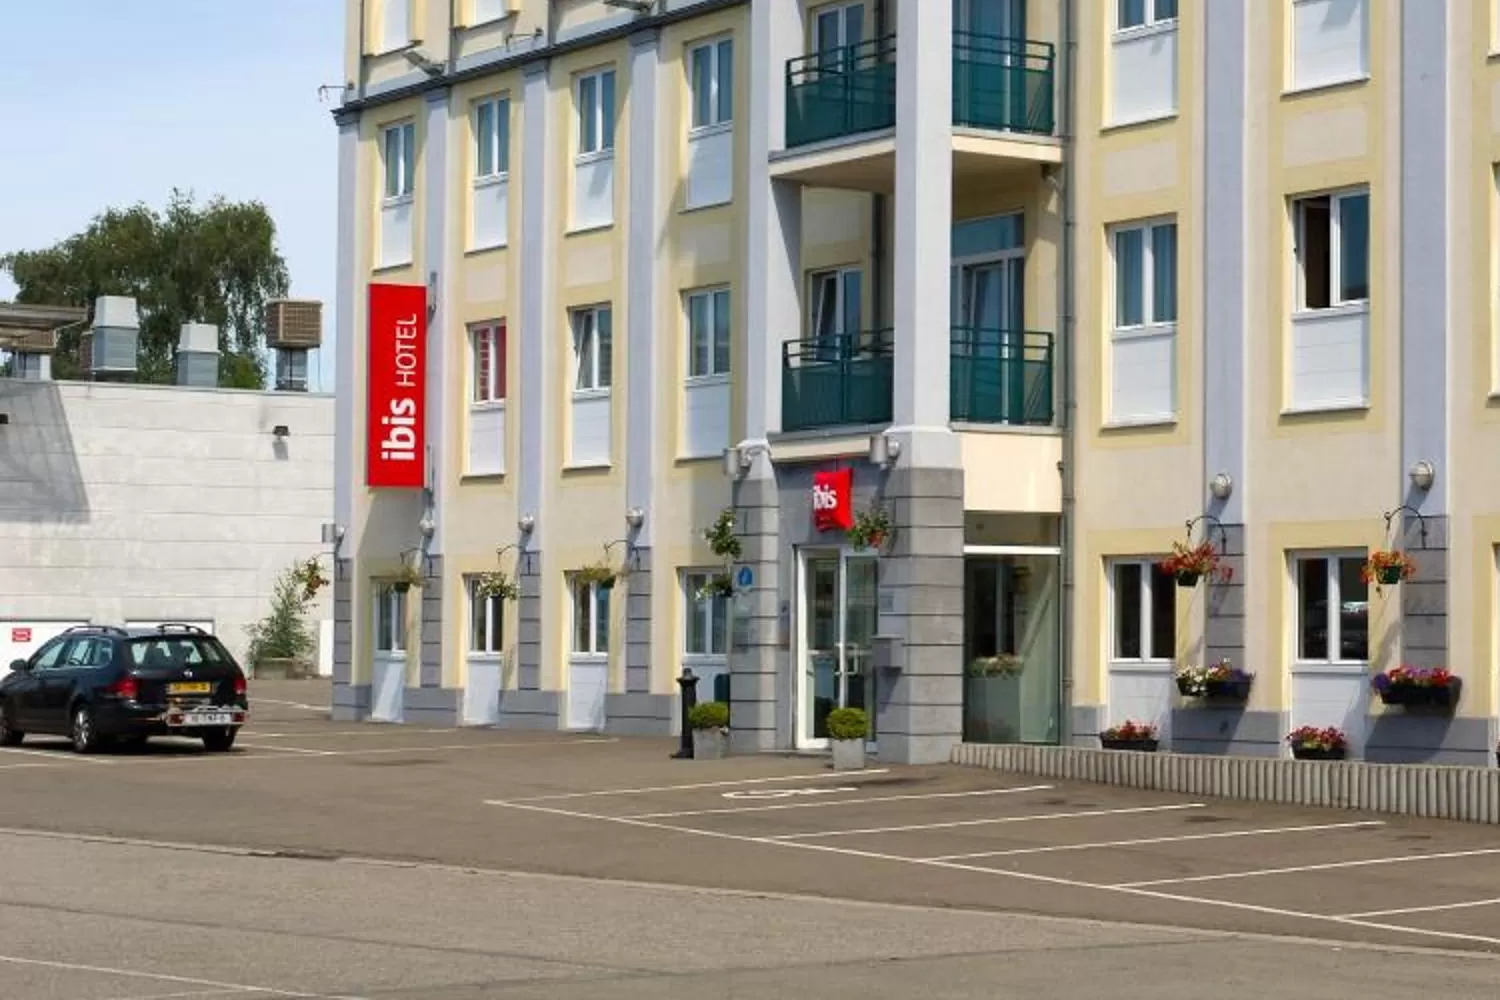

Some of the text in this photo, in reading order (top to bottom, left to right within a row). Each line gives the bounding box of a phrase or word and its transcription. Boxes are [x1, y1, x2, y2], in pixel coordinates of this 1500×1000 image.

[381, 313, 417, 461] ibis HOTEL
[813, 484, 838, 511] ibis
